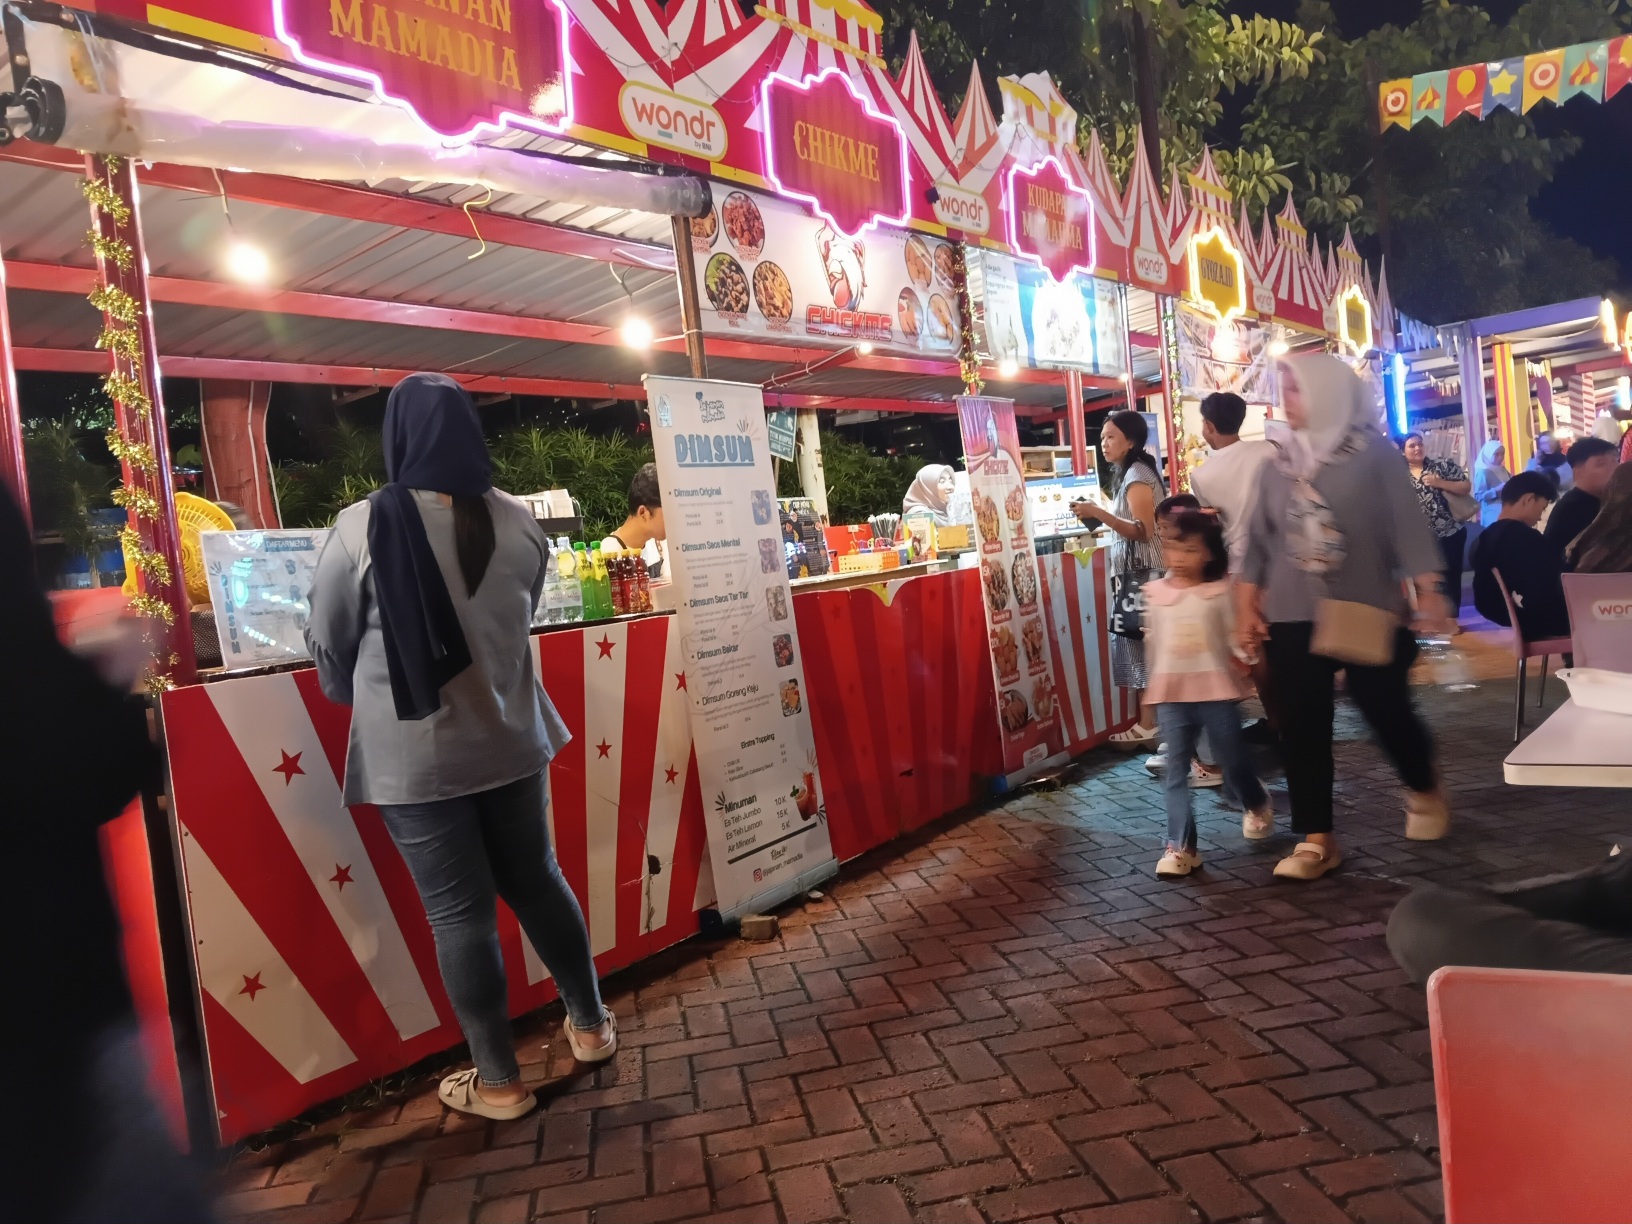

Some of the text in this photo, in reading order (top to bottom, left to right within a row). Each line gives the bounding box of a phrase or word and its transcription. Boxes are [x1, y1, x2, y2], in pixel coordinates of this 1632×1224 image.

[329, 0, 523, 92] MAMADIA
[631, 96, 716, 143] wondr
[694, 141, 713, 152] by BNI
[793, 120, 881, 183] CHIKME
[938, 193, 984, 222] wondr
[1136, 255, 1164, 275] wondr
[805, 304, 893, 342] CHICKME
[674, 434, 754, 464] DIMSUM
[674, 486, 722, 498] Dimsum Original
[681, 542, 707, 552] Dimsum
[689, 597, 715, 608] Dimsum
[738, 591, 749, 599] Tar
[697, 644, 739, 660] Dimsum Bakar
[701, 683, 759, 706] Dimsum Goreng Keju
[755, 733, 775, 744] Topping
[724, 794, 758, 814] Minuman
[724, 807, 762, 828] Es Teh Jumbo
[725, 820, 763, 841] Es Teh Lemon
[727, 834, 757, 854] Air Mineral
